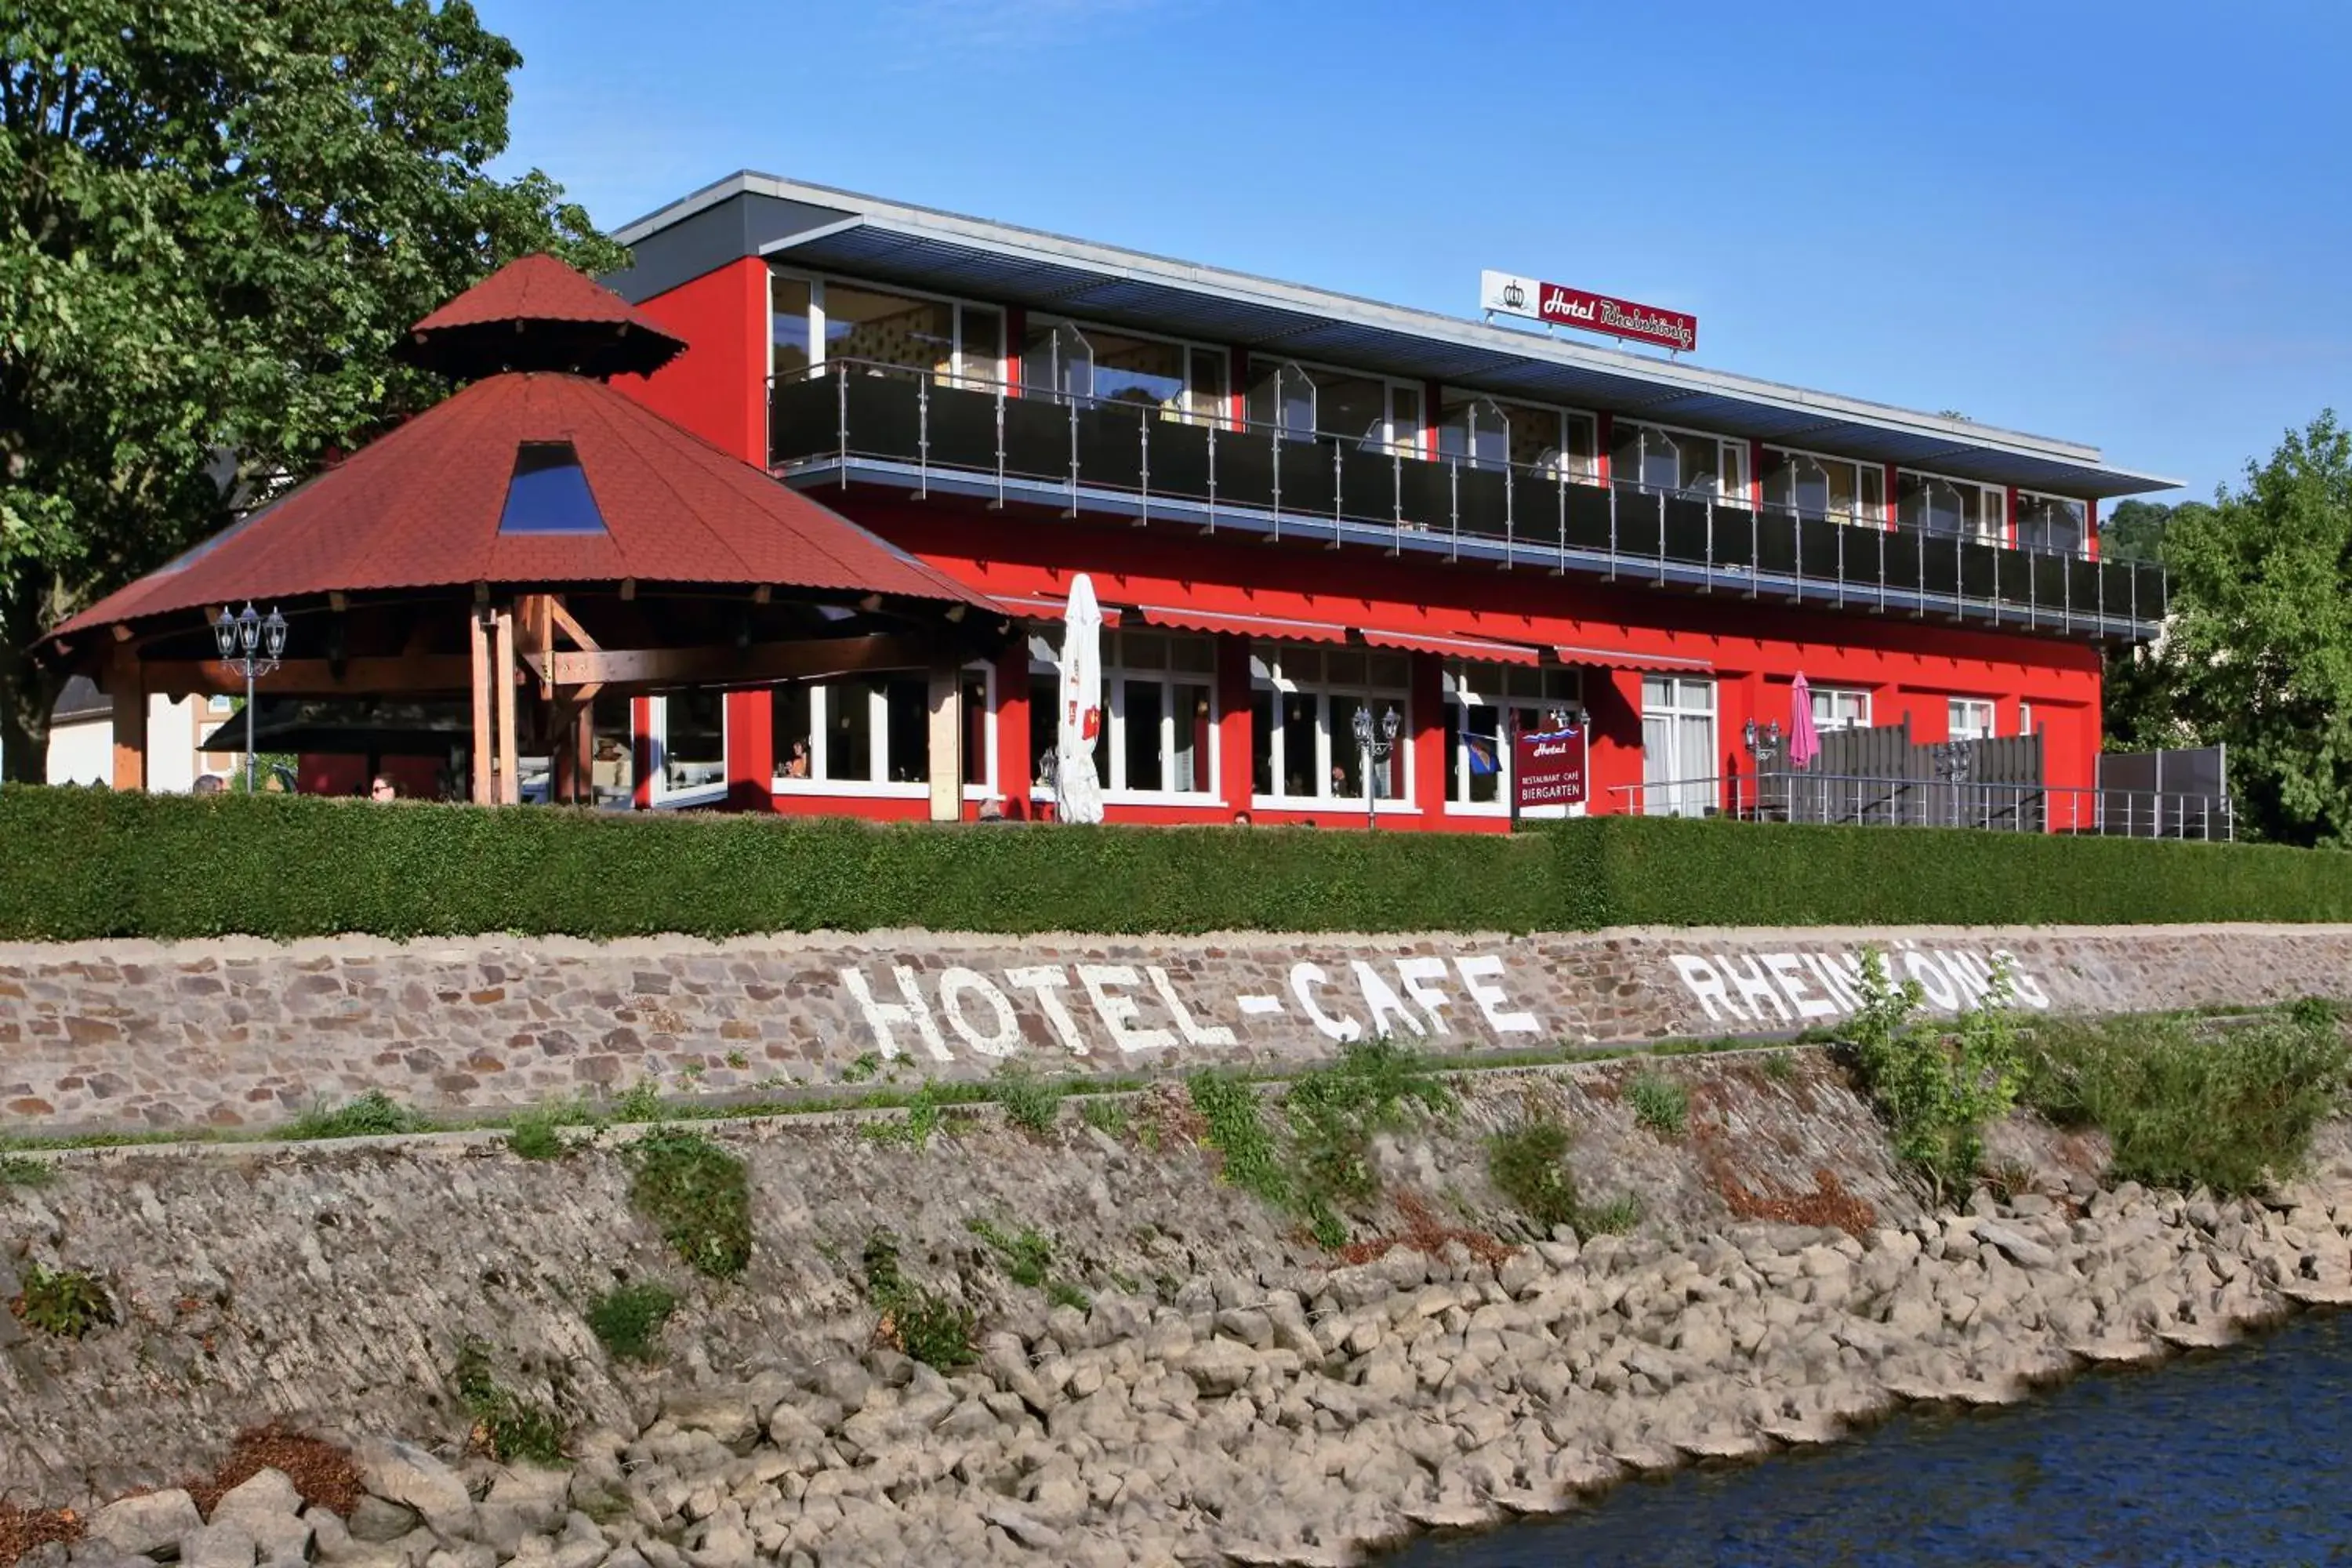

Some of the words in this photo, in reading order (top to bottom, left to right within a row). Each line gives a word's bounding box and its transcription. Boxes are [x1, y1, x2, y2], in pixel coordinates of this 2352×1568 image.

[1544, 288, 1595, 321] Hotel
[1534, 743, 1566, 757] Hotel
[1523, 774, 1559, 784] RESTAURANT
[1522, 785, 1580, 800] BIERGARTEN
